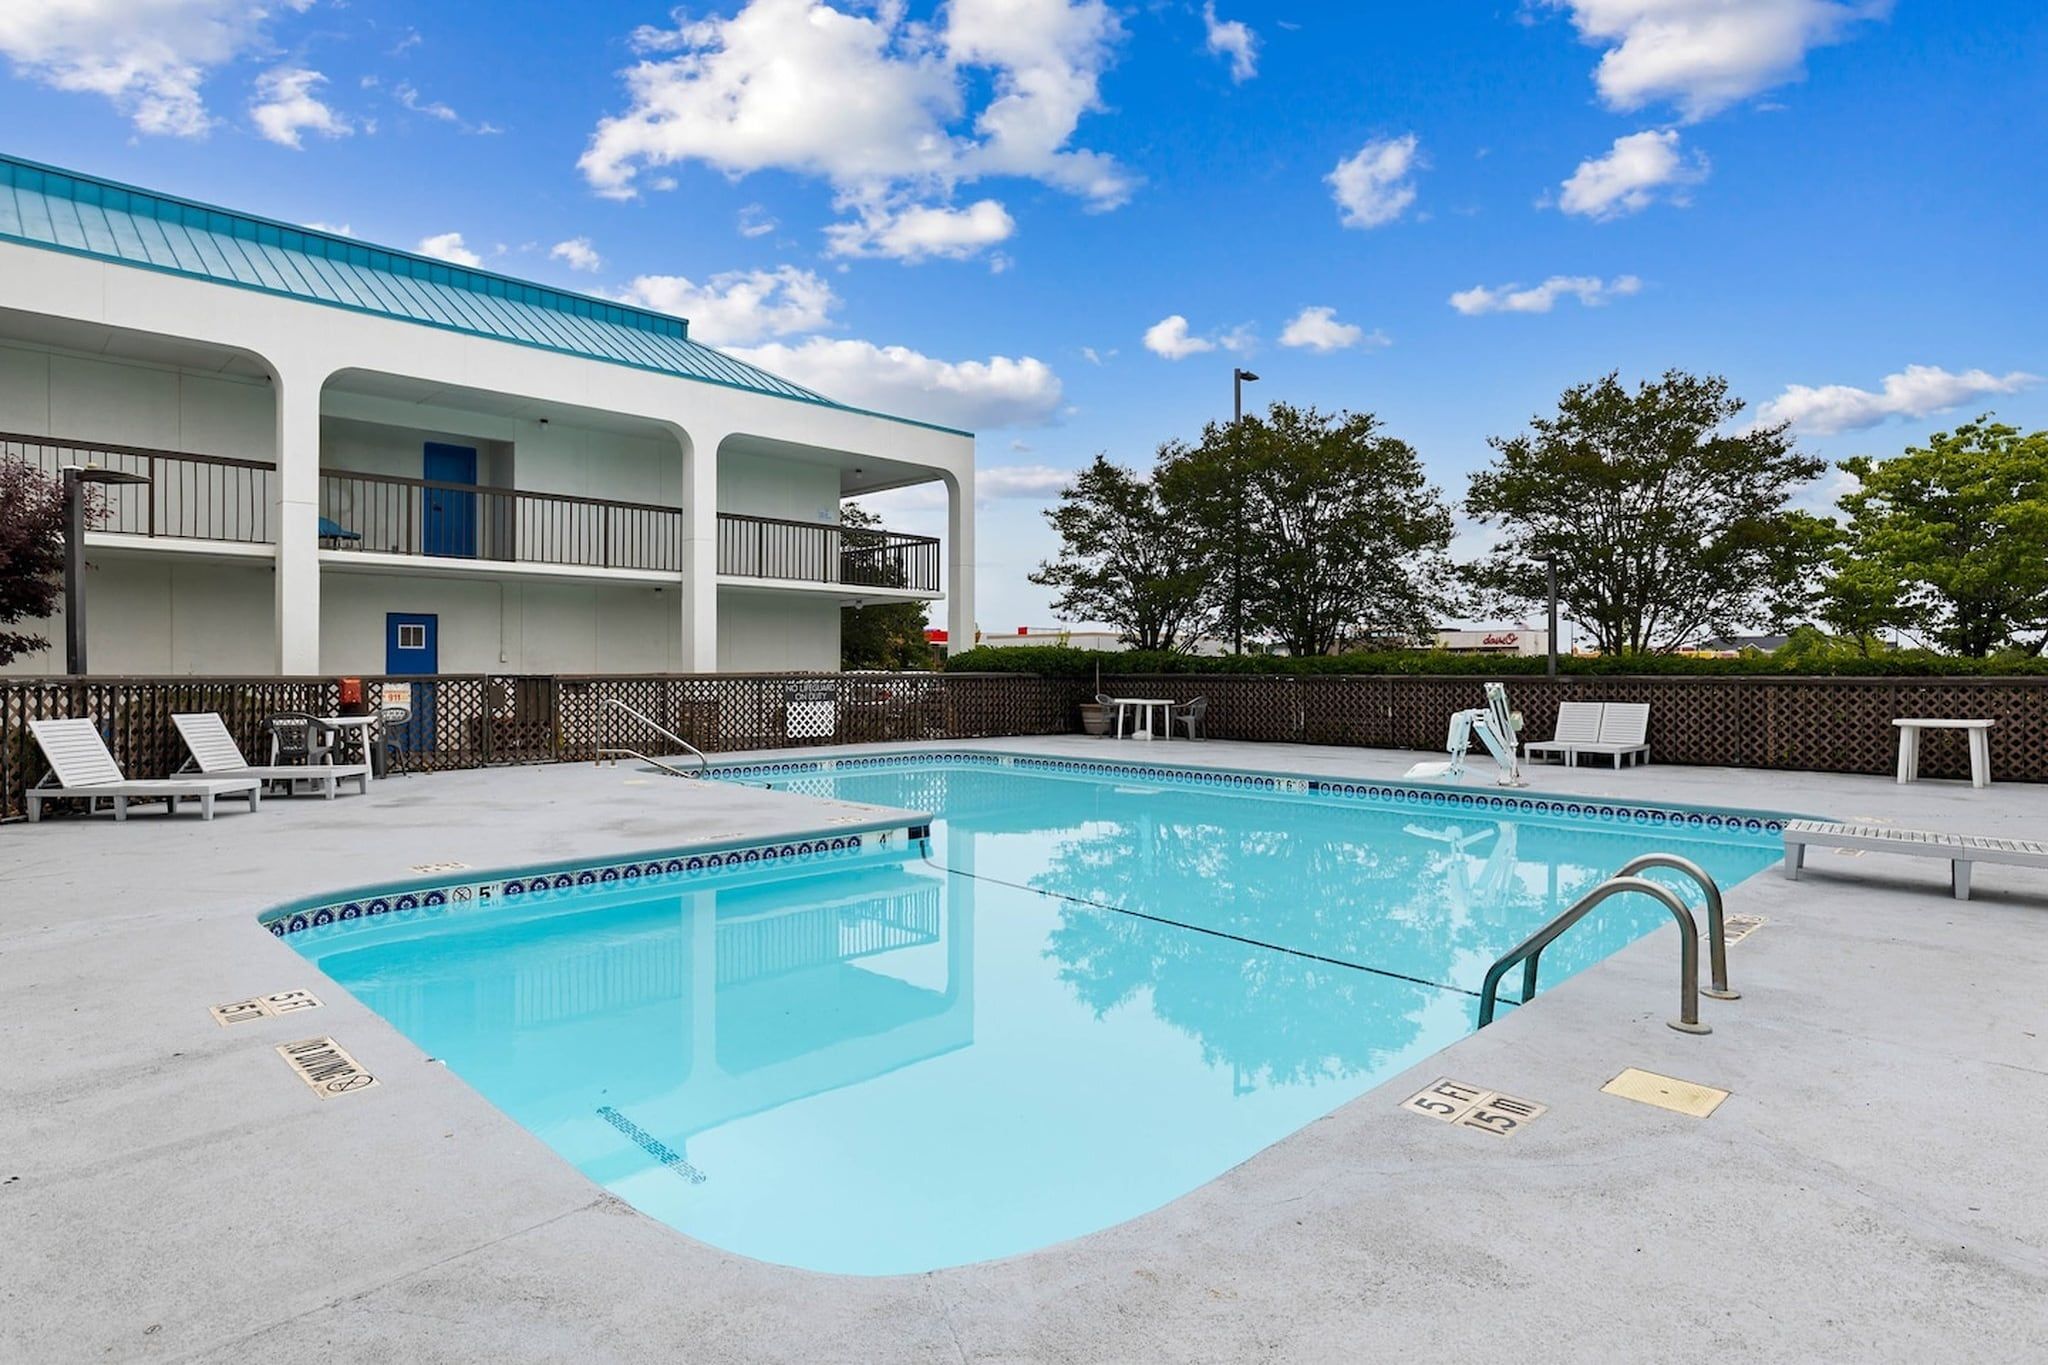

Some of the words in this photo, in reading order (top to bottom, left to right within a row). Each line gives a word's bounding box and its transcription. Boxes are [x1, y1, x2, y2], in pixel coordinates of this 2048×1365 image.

[388, 693, 401, 702] 911
[795, 692, 807, 700] ON
[1432, 1081, 1480, 1102] FT
[1413, 1097, 1456, 1115] 5
